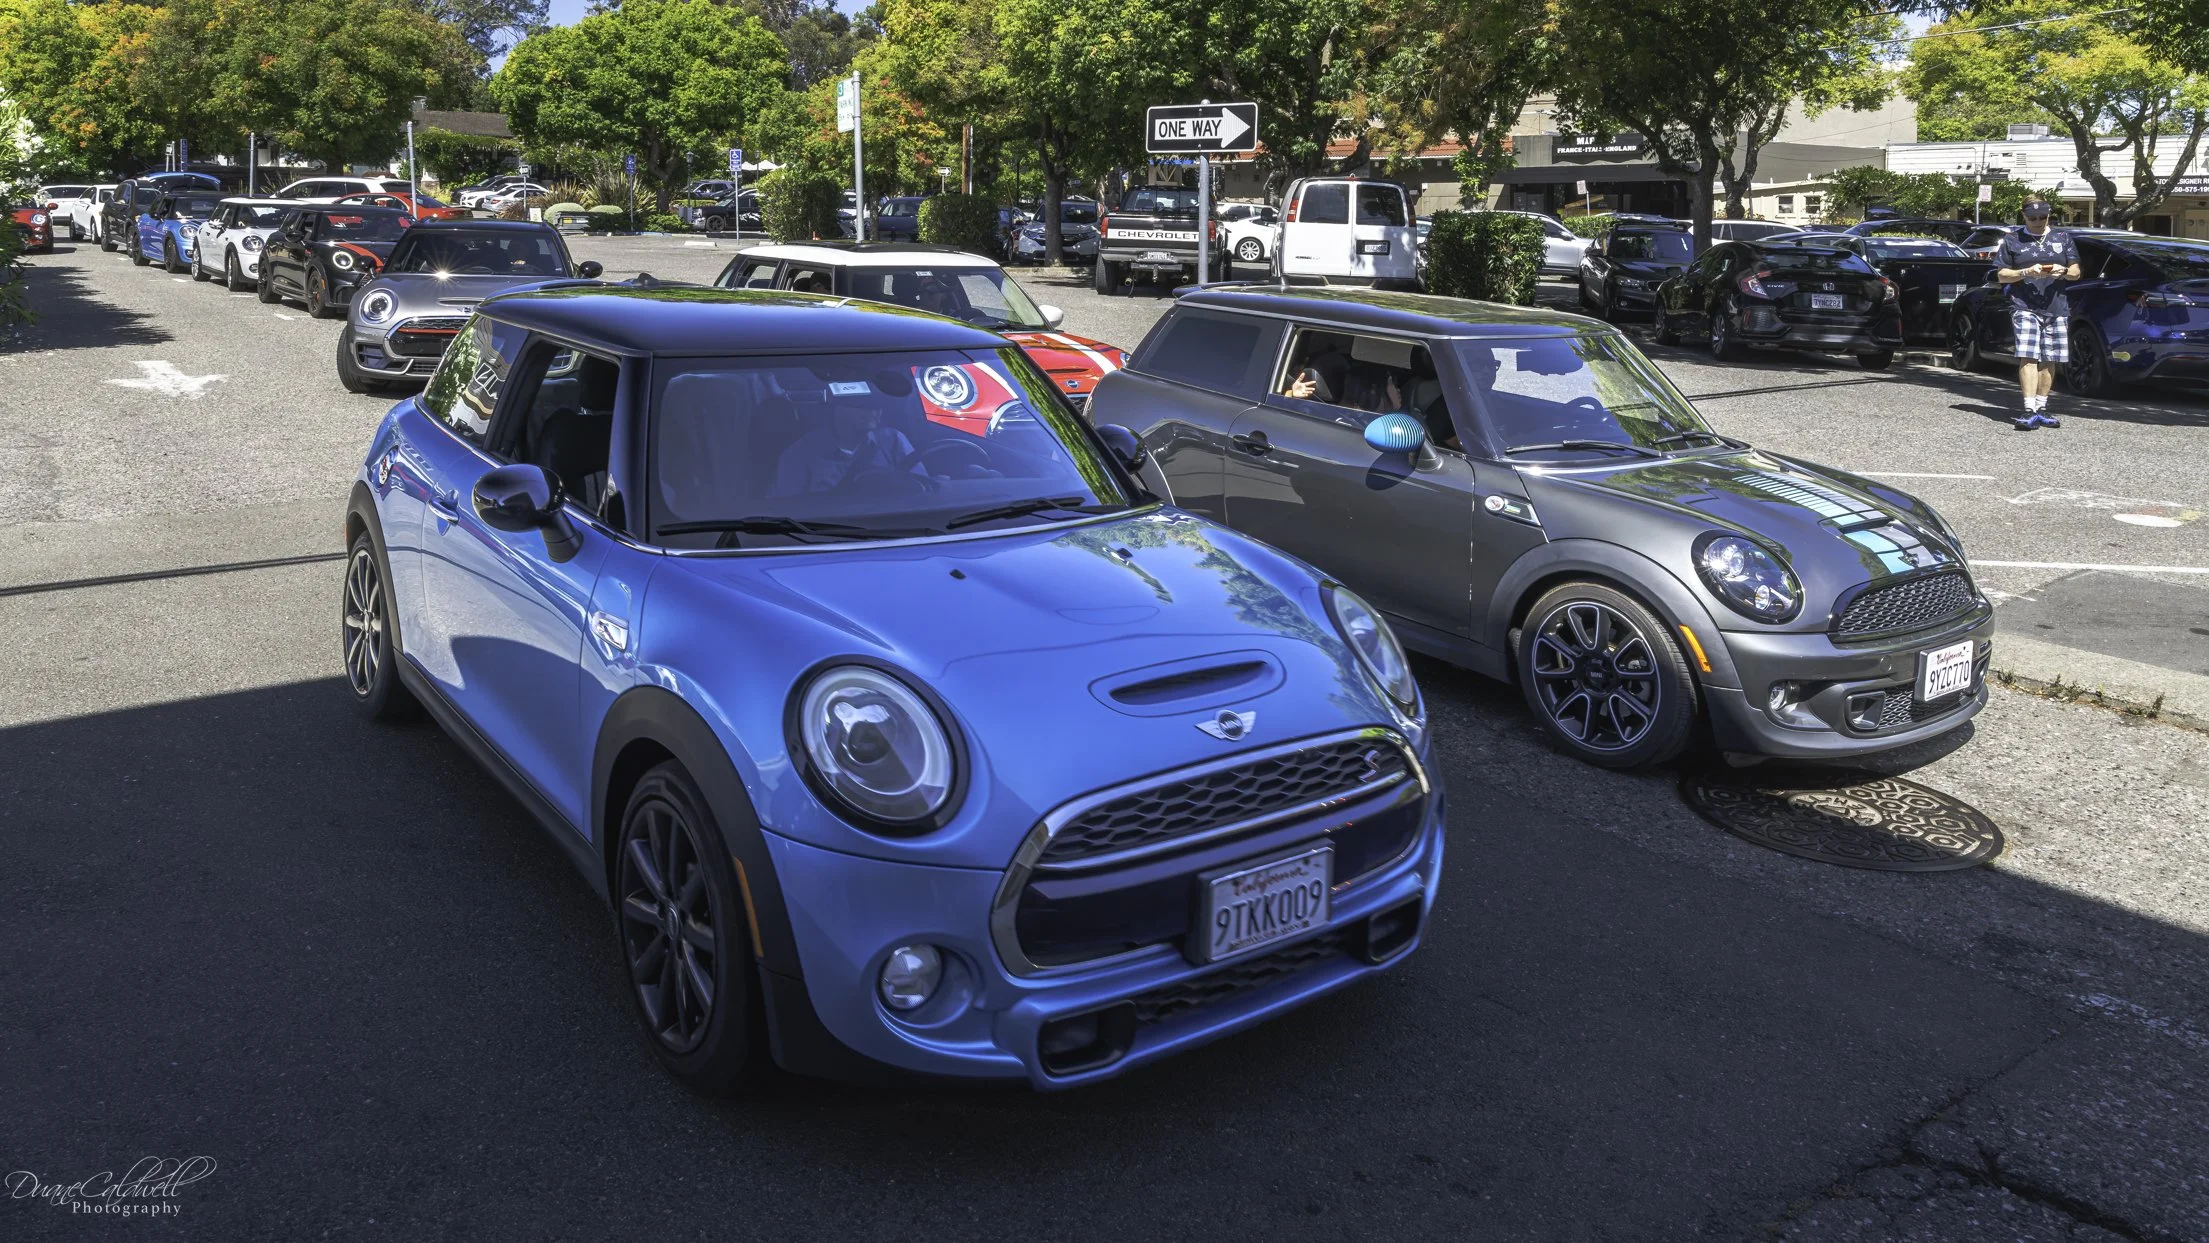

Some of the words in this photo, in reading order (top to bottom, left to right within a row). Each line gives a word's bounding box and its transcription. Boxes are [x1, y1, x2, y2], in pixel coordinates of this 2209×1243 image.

[1159, 121, 1186, 138] ONE
[1192, 120, 1221, 137] WAY
[1118, 230, 1199, 240] CHEVROLET
[1929, 660, 1969, 694] 9YZC770
[1215, 879, 1323, 947] 9TKK009
